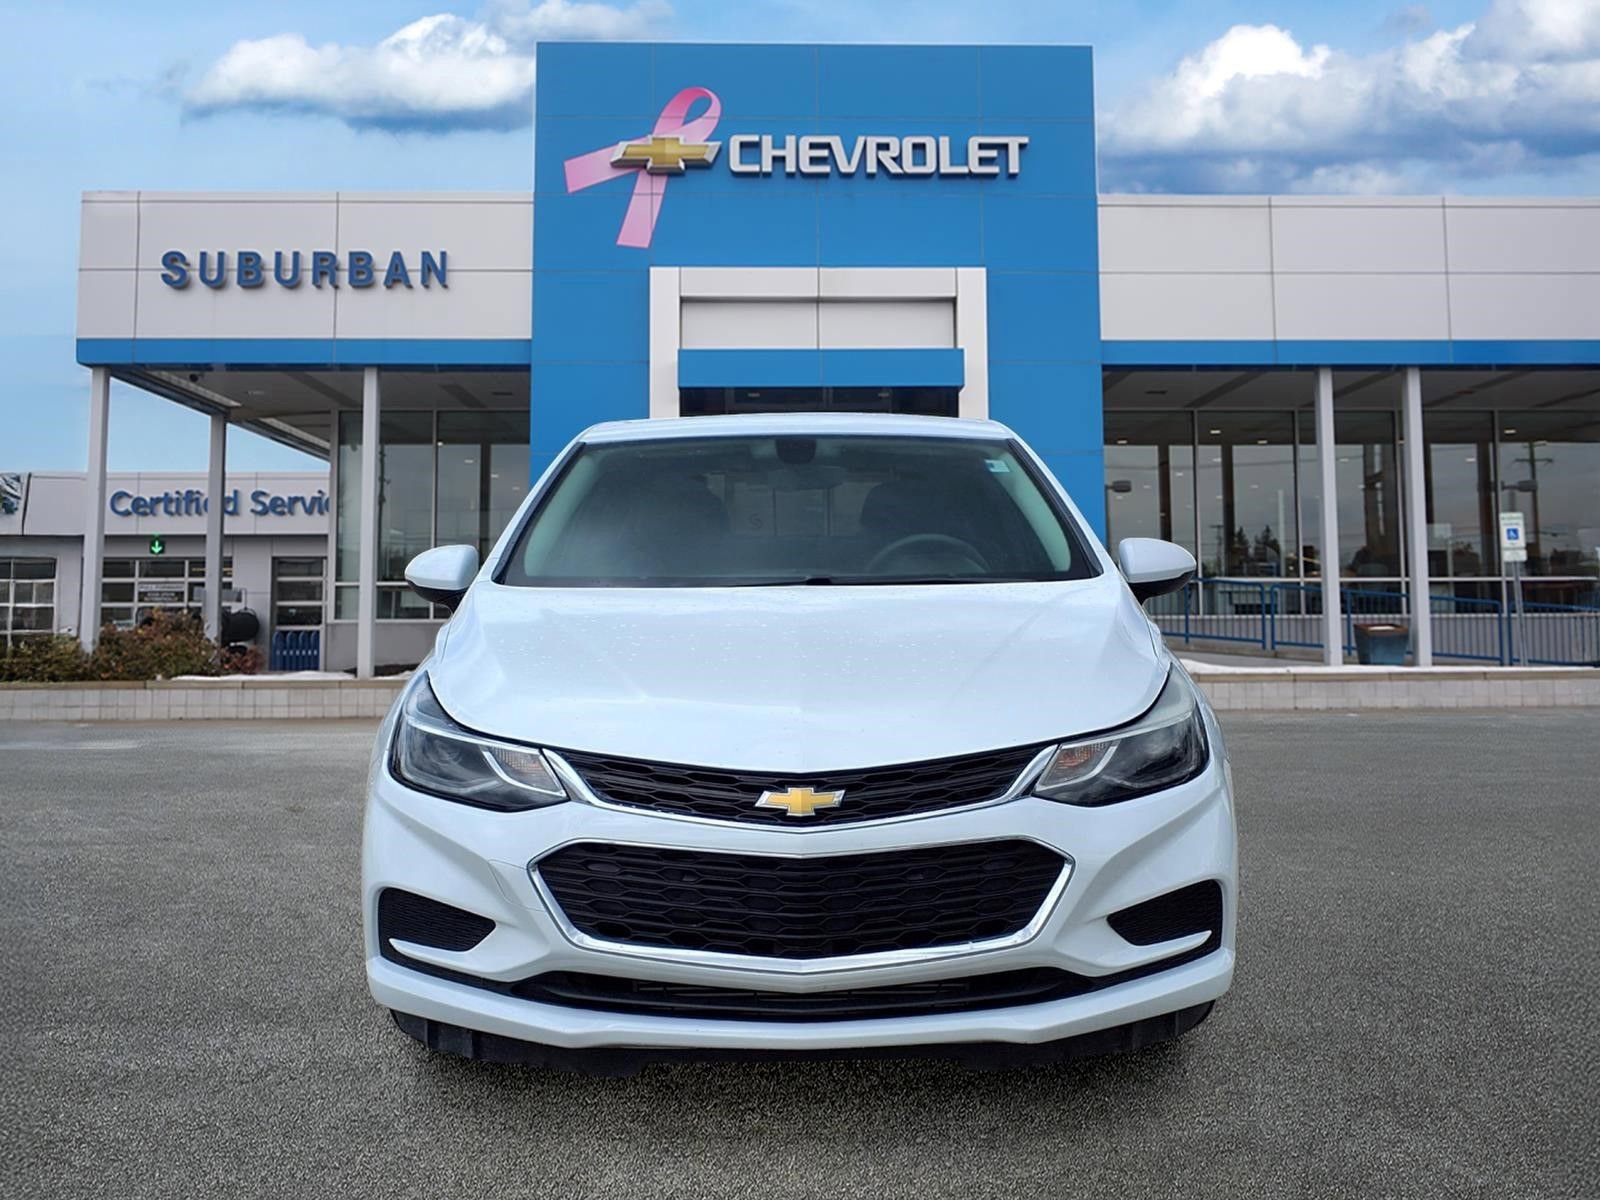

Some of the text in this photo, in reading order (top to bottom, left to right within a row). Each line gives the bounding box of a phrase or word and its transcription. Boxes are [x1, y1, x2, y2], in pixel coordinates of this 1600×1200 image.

[729, 134, 1029, 176] CHEVROLET
[160, 250, 449, 290] SUBURBAN
[250, 489, 330, 517] Servi
